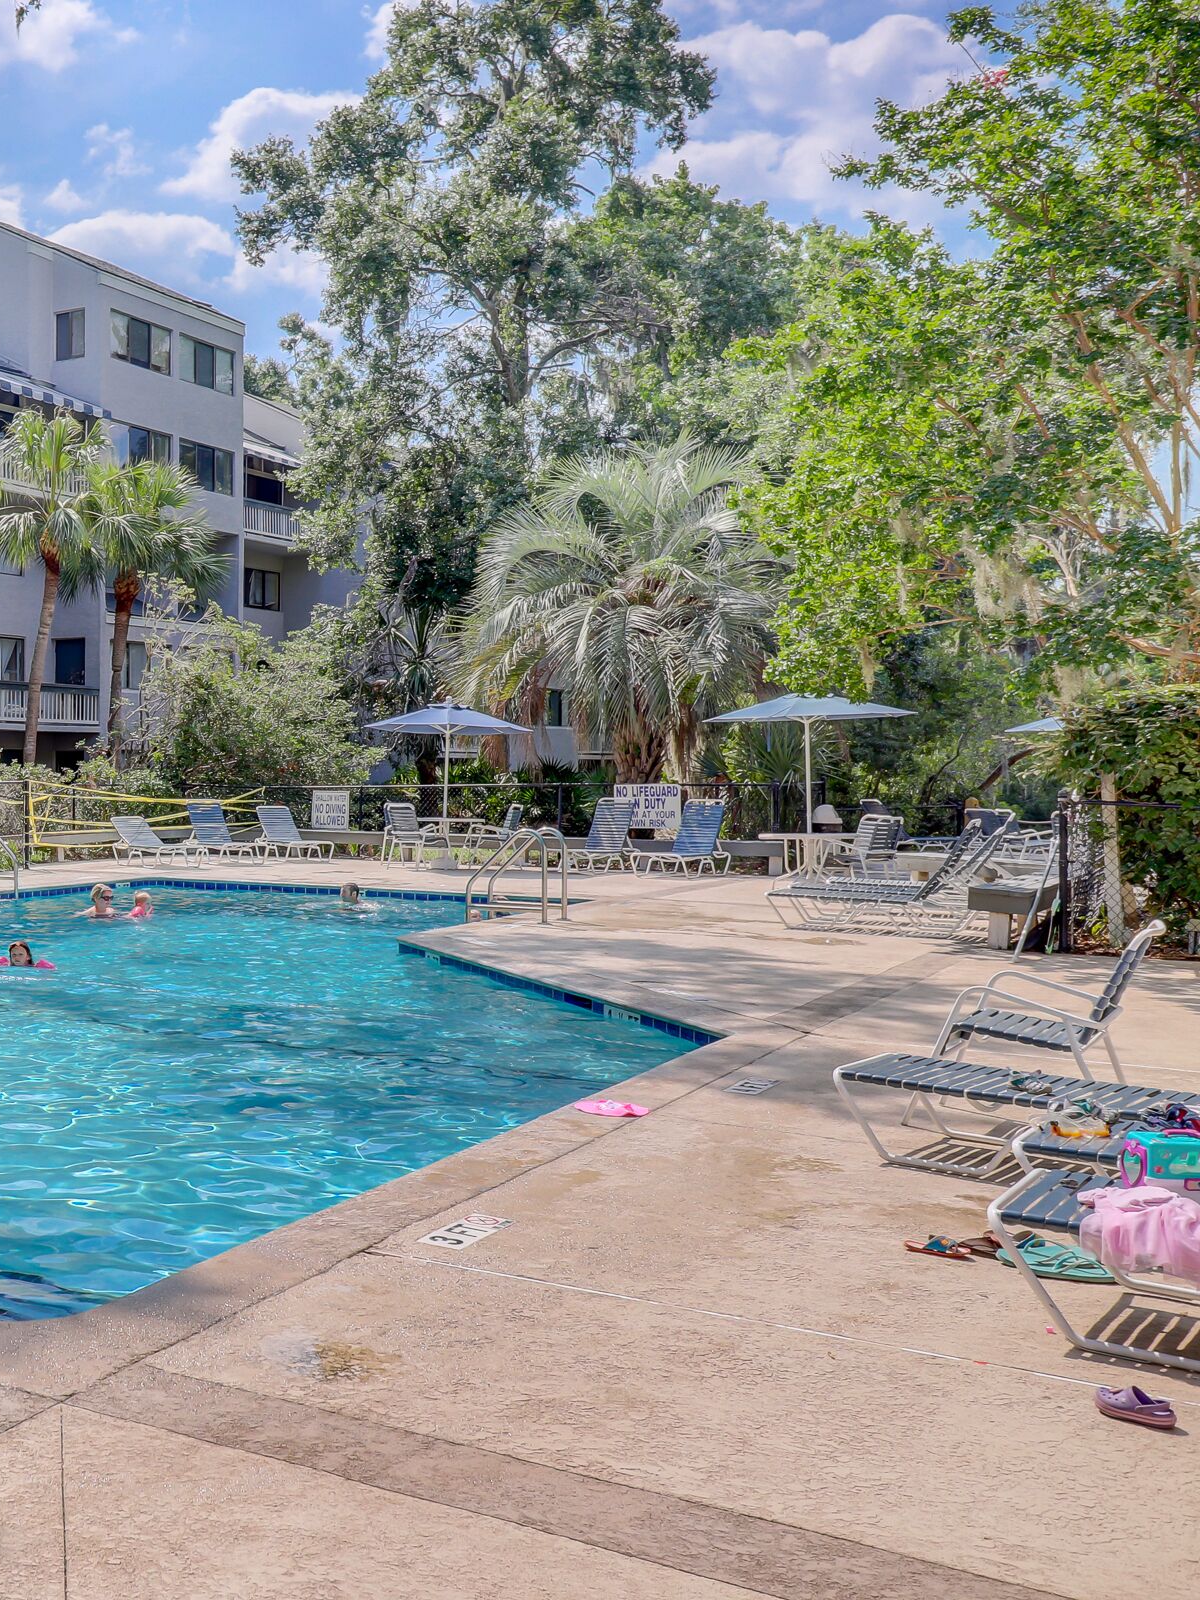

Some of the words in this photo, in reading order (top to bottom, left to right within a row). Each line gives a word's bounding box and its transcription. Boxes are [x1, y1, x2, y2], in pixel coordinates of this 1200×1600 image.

[616, 786, 627, 797] NO
[632, 786, 678, 797] LIFEGUARD
[645, 798, 665, 809] DUTY
[315, 804, 323, 813] NO
[326, 804, 346, 814] DIVING
[315, 815, 345, 825] ALLOWED
[444, 1223, 489, 1238] FT
[429, 1235, 464, 1245] 3
